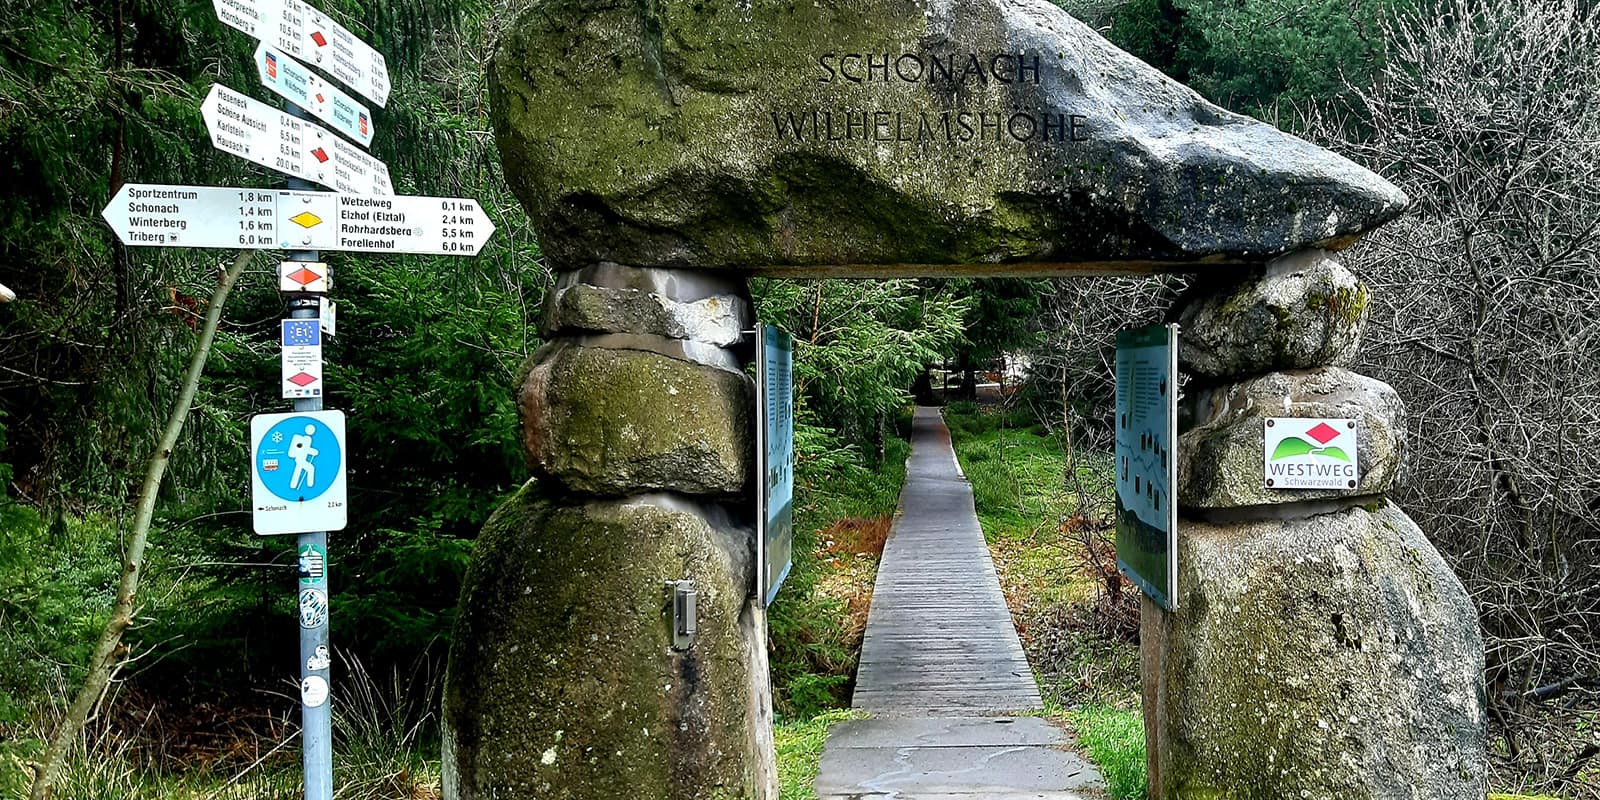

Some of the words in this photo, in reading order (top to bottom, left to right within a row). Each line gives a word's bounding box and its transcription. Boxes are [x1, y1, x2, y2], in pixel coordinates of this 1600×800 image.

[293, 1, 301, 13] km
[221, 8, 249, 32] Hornberg
[292, 15, 301, 27] km
[279, 23, 291, 37] 10,5
[292, 29, 301, 42] km
[279, 37, 290, 51] 11,5
[291, 43, 300, 55] km
[817, 52, 1041, 84] SCHONACH
[217, 88, 248, 109] Haseneck
[217, 119, 245, 138] Karlstein
[241, 114, 267, 133] Aussicht
[291, 119, 300, 131] km
[770, 102, 1090, 143] WILHELMSHÖHE
[216, 133, 243, 152] Hausach
[291, 134, 300, 145] km
[291, 148, 300, 159] km
[291, 162, 300, 173] km
[128, 187, 198, 201] Sportzentrum
[238, 192, 254, 204] 1,8
[257, 193, 273, 203] km
[128, 202, 179, 214] Schonach
[340, 196, 393, 210] Wetzelweg
[441, 201, 456, 212] 0,1
[459, 202, 474, 212] km
[238, 206, 254, 218] 1,4
[257, 207, 273, 217] km
[341, 210, 370, 221] Elzhof
[372, 211, 406, 224] (Elztal)
[128, 216, 187, 229] Winterberg
[238, 220, 254, 232] 1,6
[257, 221, 273, 231] km
[441, 215, 456, 226] 2,4
[459, 215, 474, 225] km
[341, 224, 412, 236] Rohrhardsberg
[441, 228, 456, 239] 5,5
[459, 229, 474, 239] km
[128, 231, 165, 244] Triberg
[238, 235, 255, 247] 6,0
[257, 235, 273, 245] km
[341, 237, 395, 249] Forellenhof
[441, 241, 457, 252] 6,0
[459, 242, 474, 252] km
[296, 327, 308, 337] E1
[1269, 463, 1354, 477] WESTWEG
[1284, 477, 1343, 487] Schwarzwald
